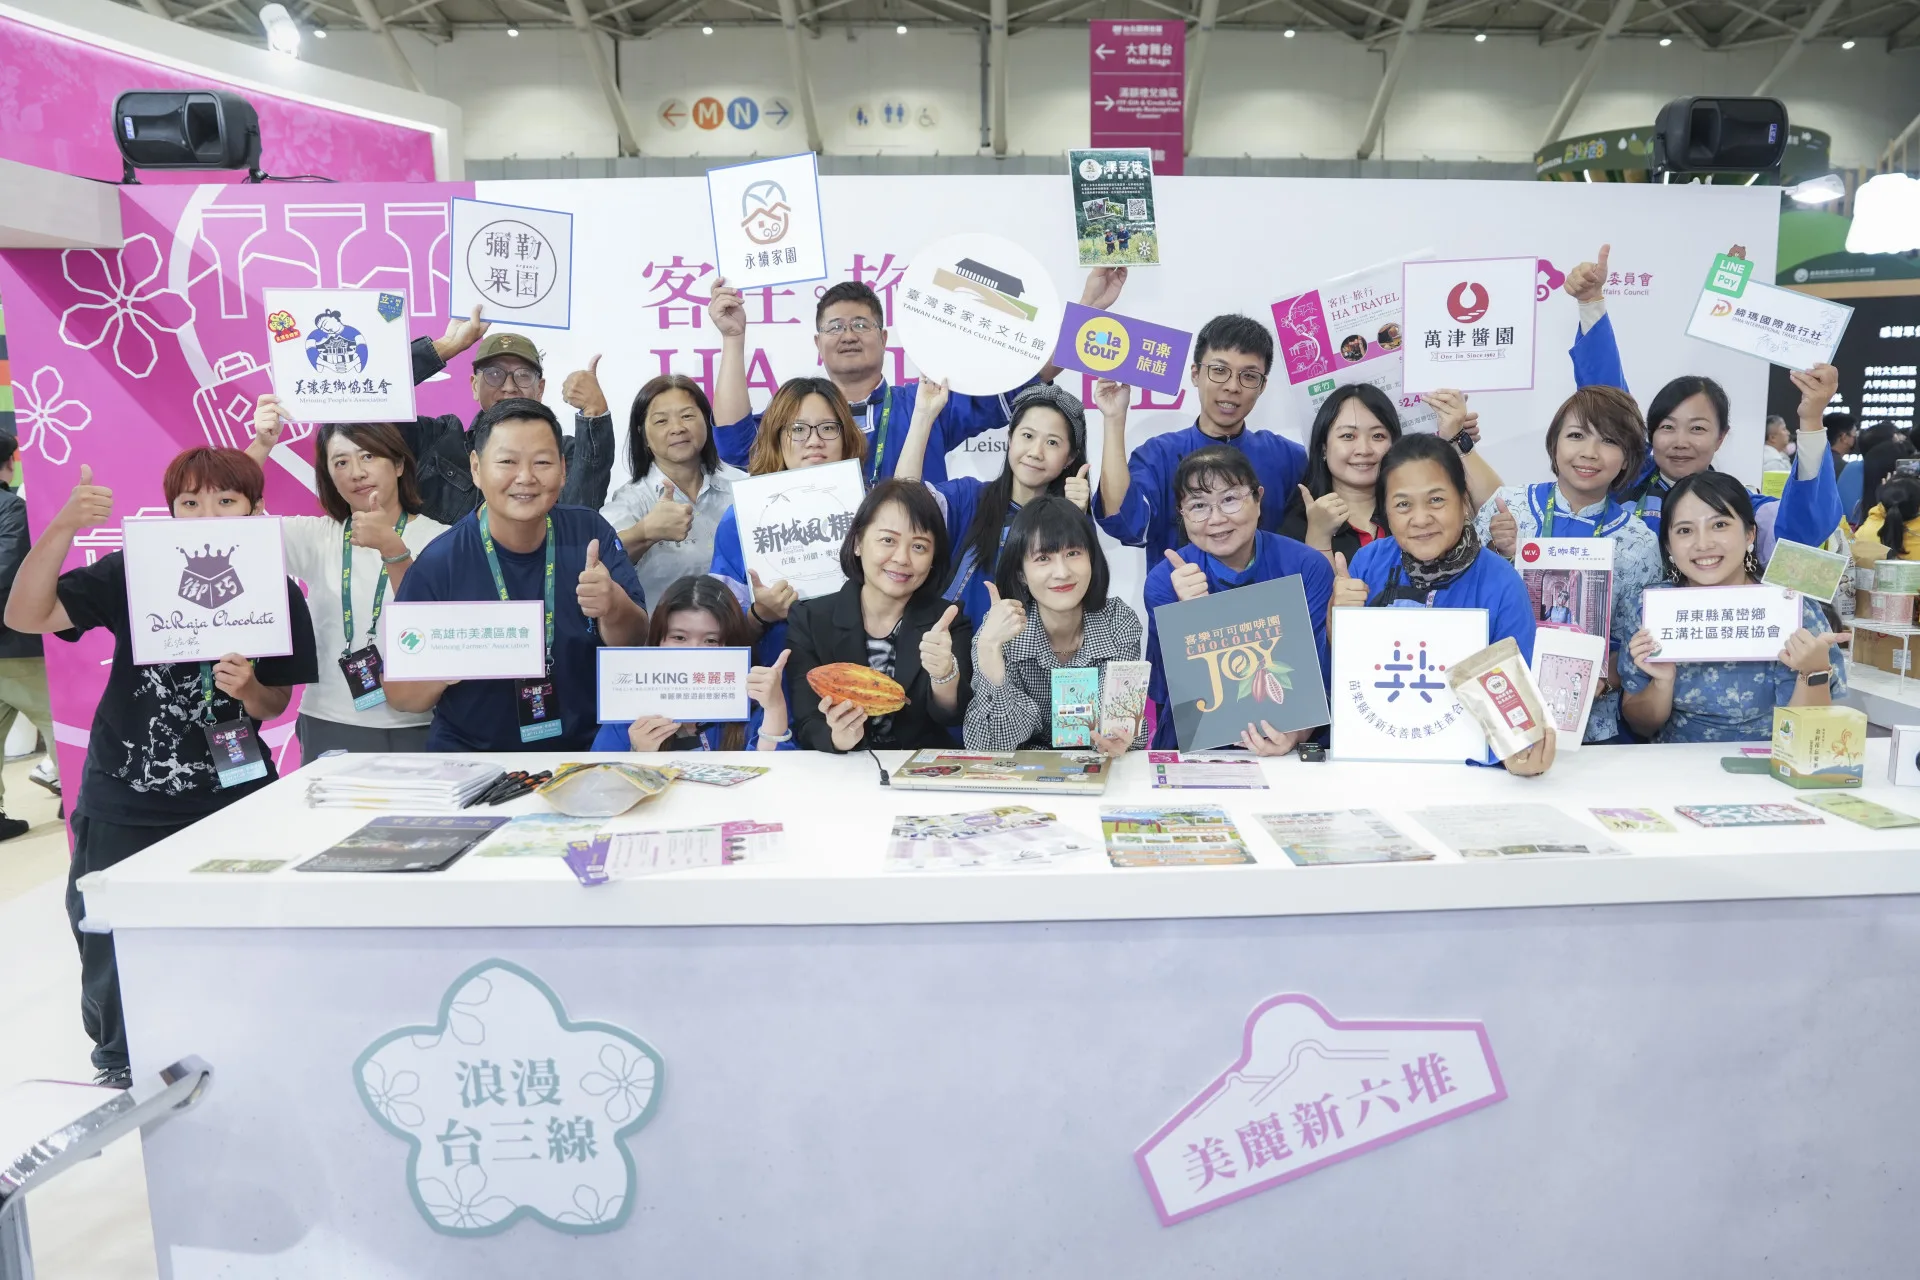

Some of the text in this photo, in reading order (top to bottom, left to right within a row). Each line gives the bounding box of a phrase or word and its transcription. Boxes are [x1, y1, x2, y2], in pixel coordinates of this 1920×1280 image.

[1127, 57, 1171, 67] Main Stage
[698, 102, 751, 125] M N
[485, 231, 542, 261] 彌勒
[745, 246, 797, 270] 永續家園
[1719, 259, 1746, 275] LINE
[483, 266, 539, 298] 果園
[1600, 288, 1650, 296] ffairs Council
[1717, 274, 1737, 288] Pay
[1331, 309, 1351, 322] HA
[1351, 292, 1400, 315] TRAVEL
[905, 287, 1046, 352] 臺灣客家茶文化館
[902, 302, 1041, 361] TAIWAN HAKKA TEA CULTURE MUSEUM
[1424, 326, 1514, 349] 萬津醬園
[1781, 330, 1799, 342] TRAVEL
[1798, 335, 1820, 347] SERVICE
[1083, 341, 1120, 361] tour
[1466, 352, 1483, 360] Since
[1136, 355, 1168, 377] 旅遊
[752, 511, 855, 555] 新城風糖
[181, 575, 238, 601] 御巧
[212, 609, 276, 628] Chocolate
[1675, 607, 1766, 623] 屏東縣萬巒鄉
[430, 626, 530, 640] 高雄市美濃區農會
[1184, 614, 1282, 647] 喜樂可可咖啡園
[1186, 626, 1284, 656] CHOCOLATE
[1660, 624, 1781, 641] 五溝社區發展協會
[491, 642, 530, 650] Association
[611, 671, 736, 686] The LI KING 樂麗景
[1187, 636, 1283, 713] JOY
[1348, 680, 1465, 740] 苗栗縣青新友善農業生產合
[454, 1057, 562, 1108] 浪漫
[1182, 1052, 1459, 1195] 美麗新六堆
[435, 1115, 599, 1167] 台三線
